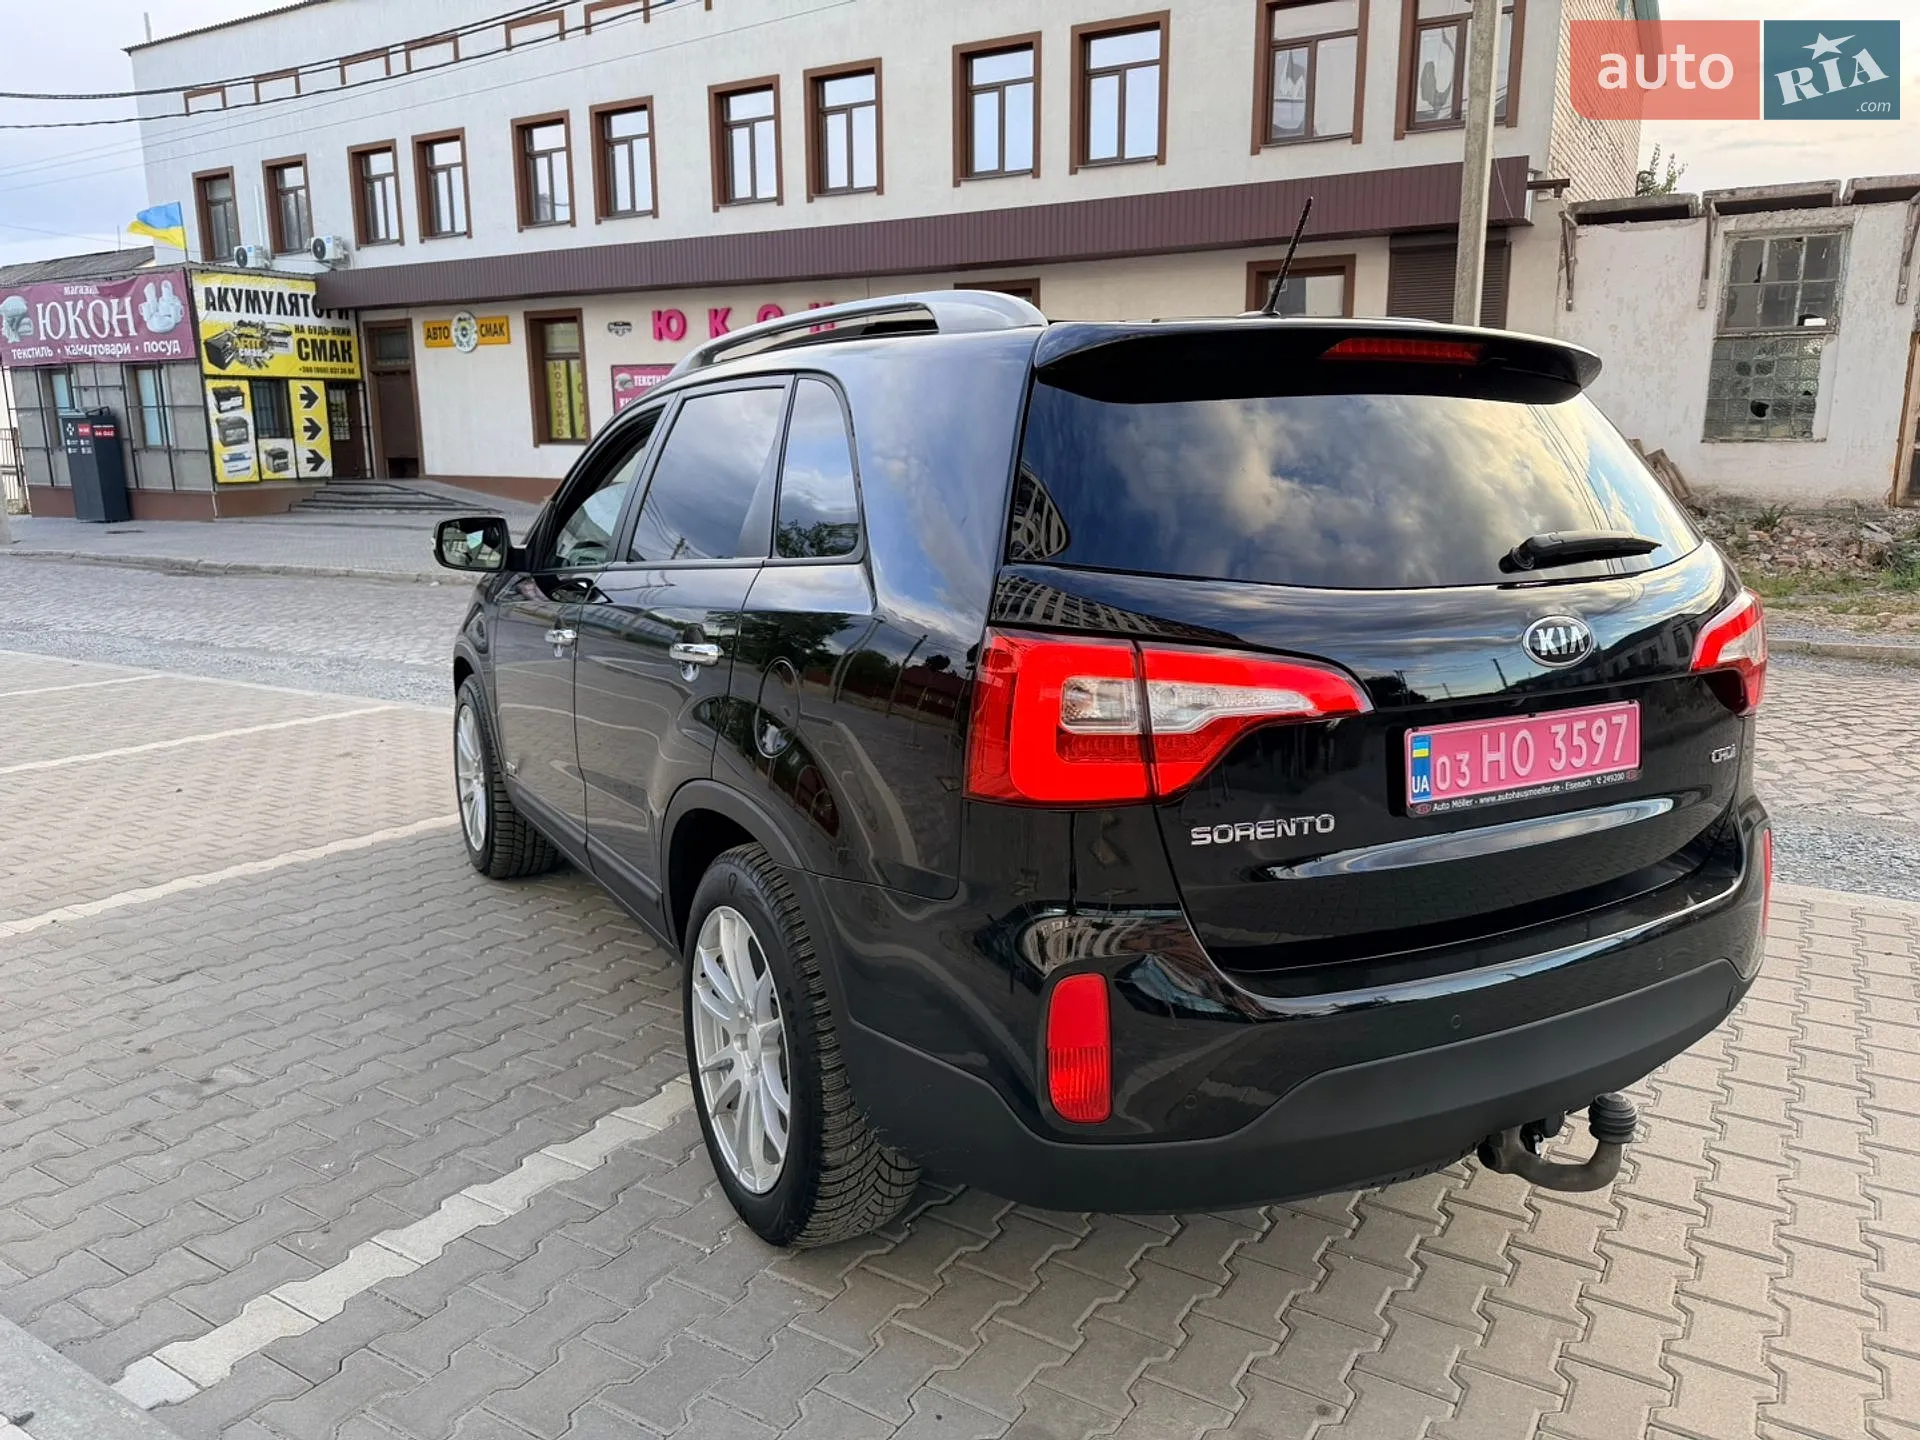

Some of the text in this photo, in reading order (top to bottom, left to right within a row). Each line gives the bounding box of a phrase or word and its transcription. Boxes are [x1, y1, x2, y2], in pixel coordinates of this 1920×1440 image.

[36, 297, 138, 341] ЮКОН
[426, 326, 450, 341] АВТО
[479, 321, 505, 337] СМАК
[11, 345, 54, 360] текстиль
[143, 339, 182, 356] посуд
[297, 337, 352, 363] СМАК
[1536, 626, 1585, 656] KIA
[1412, 714, 1628, 793] UA 03 HO 3597
[1432, 802, 1451, 811] Auto
[1565, 779, 1592, 792] Eisenach
[1190, 813, 1335, 846] SORENTO
